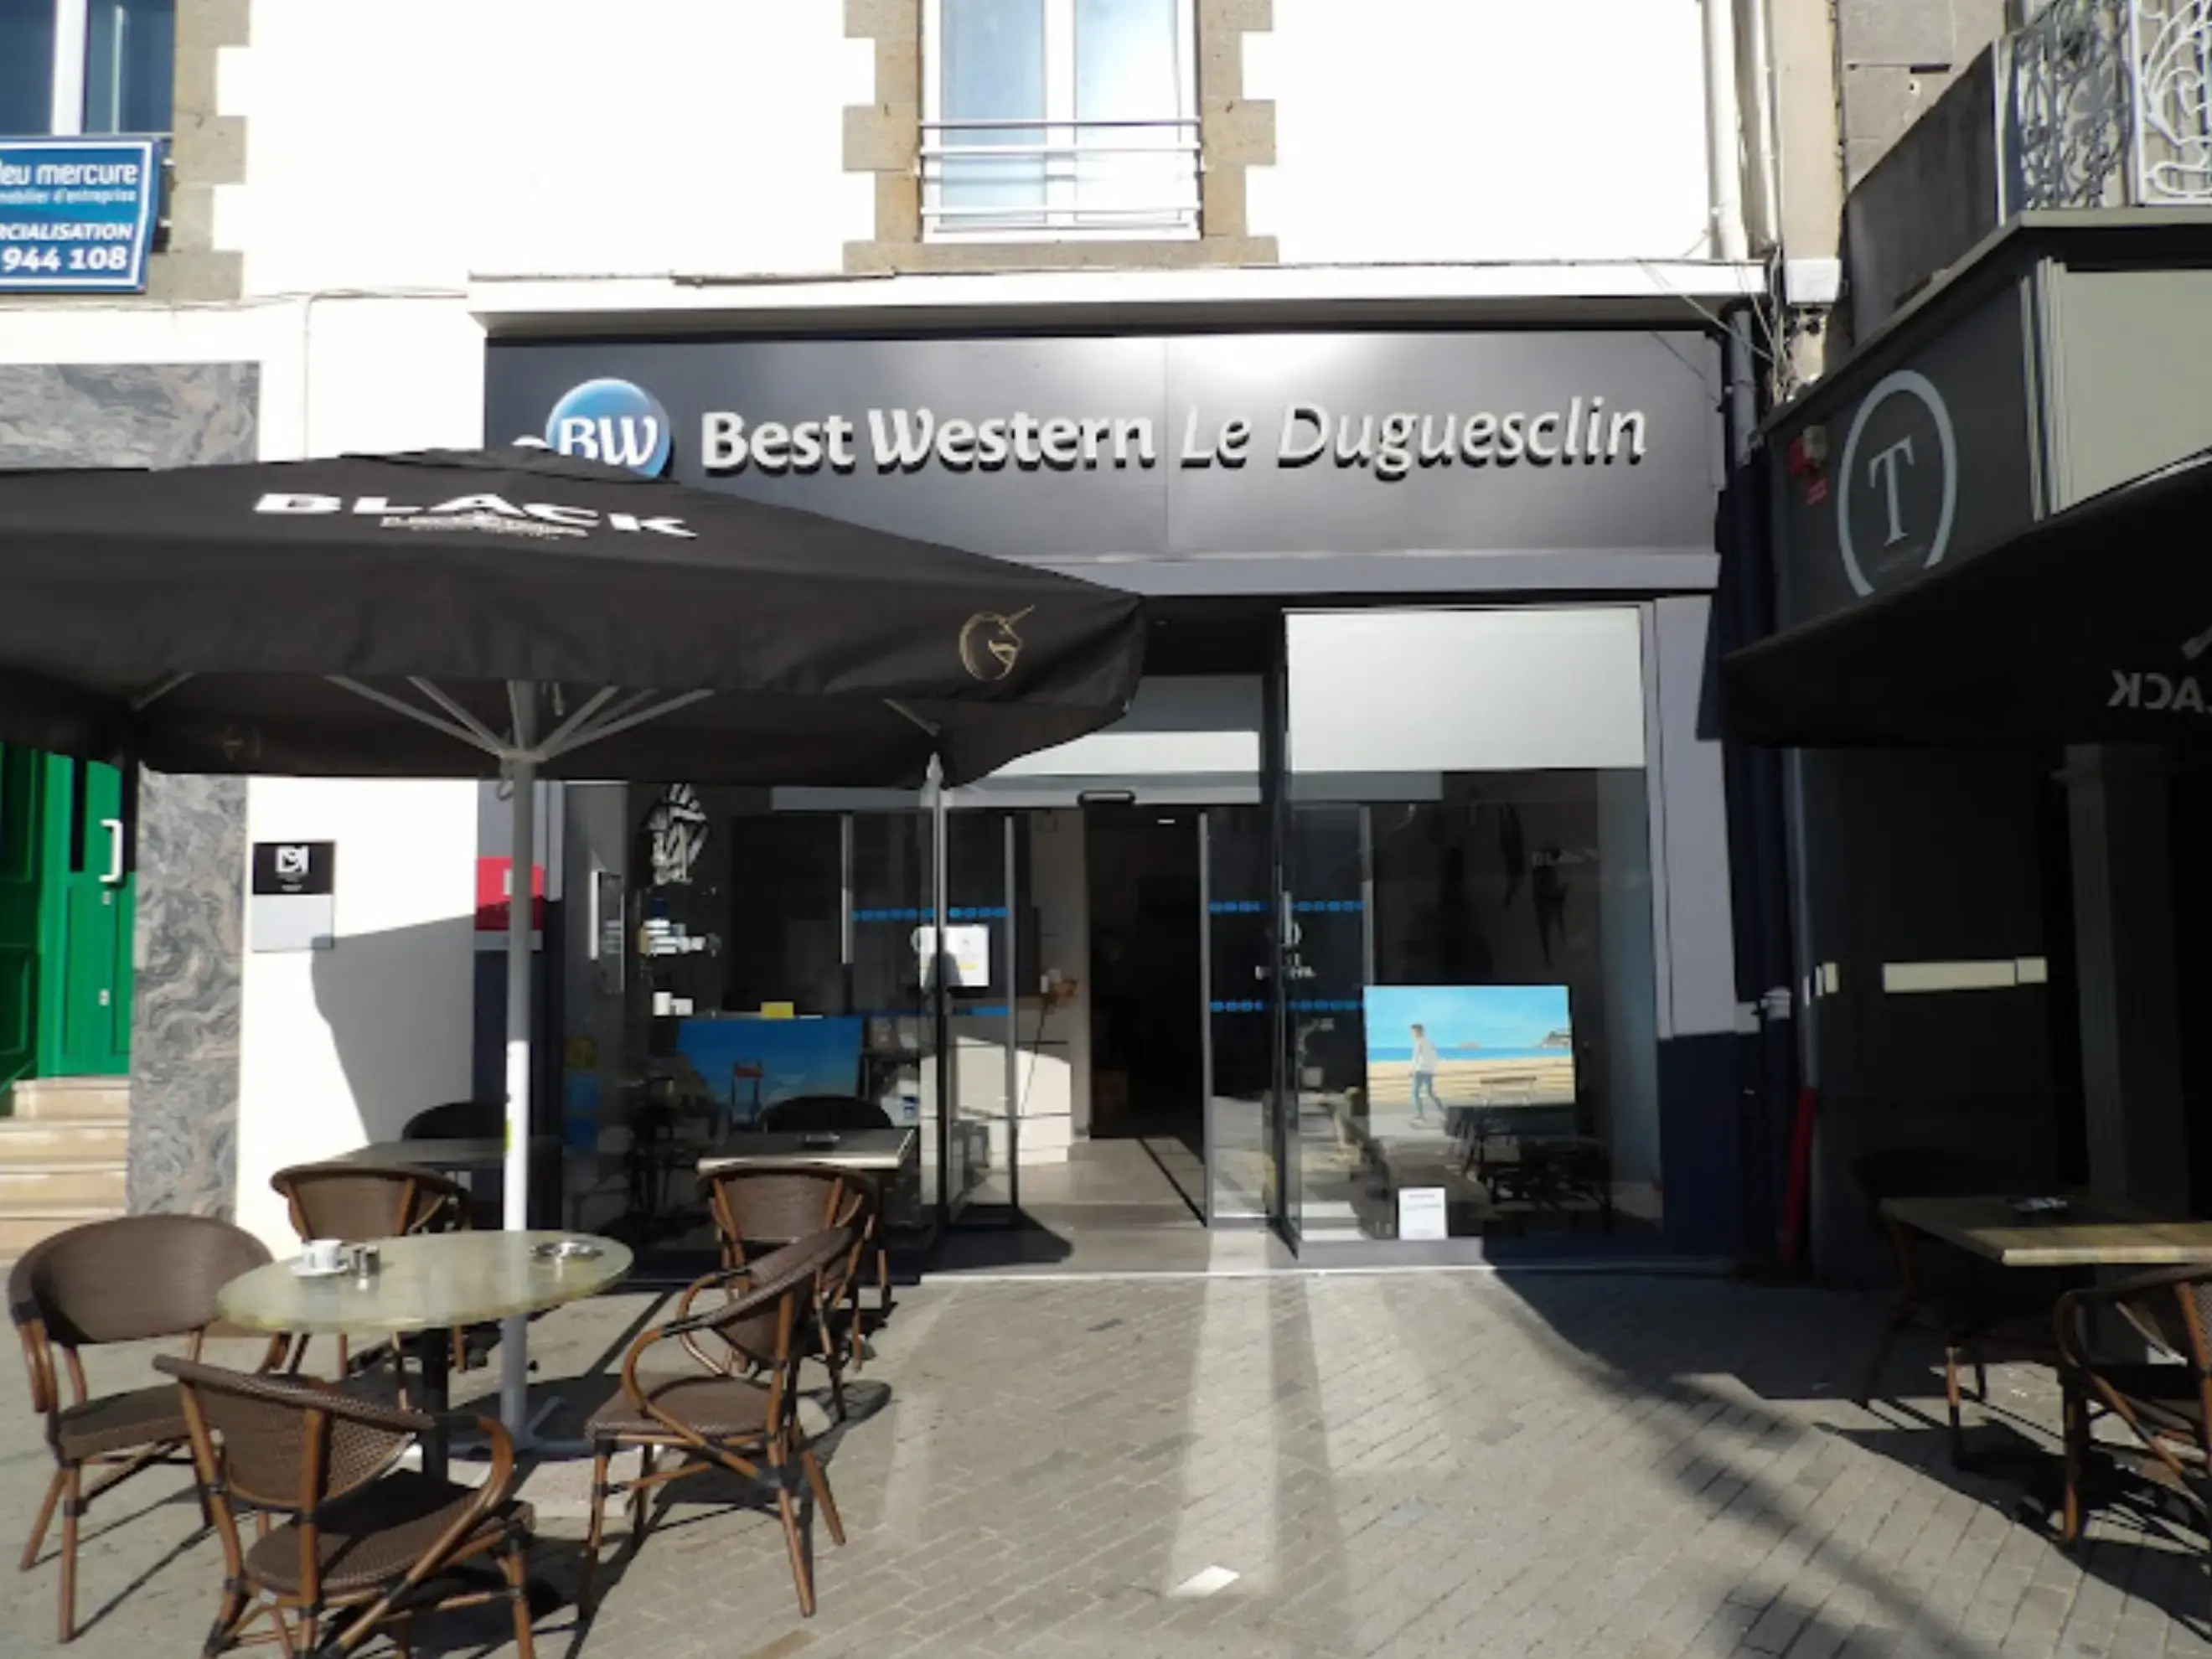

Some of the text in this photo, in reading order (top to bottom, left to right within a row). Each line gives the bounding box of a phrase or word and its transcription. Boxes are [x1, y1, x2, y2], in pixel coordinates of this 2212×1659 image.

[36, 163, 138, 185] mercure
[3, 246, 127, 272] 944 108
[702, 396, 1648, 478] Best Western Le Duguesclin
[1868, 436, 1915, 546] T
[254, 493, 697, 539] BLACK
